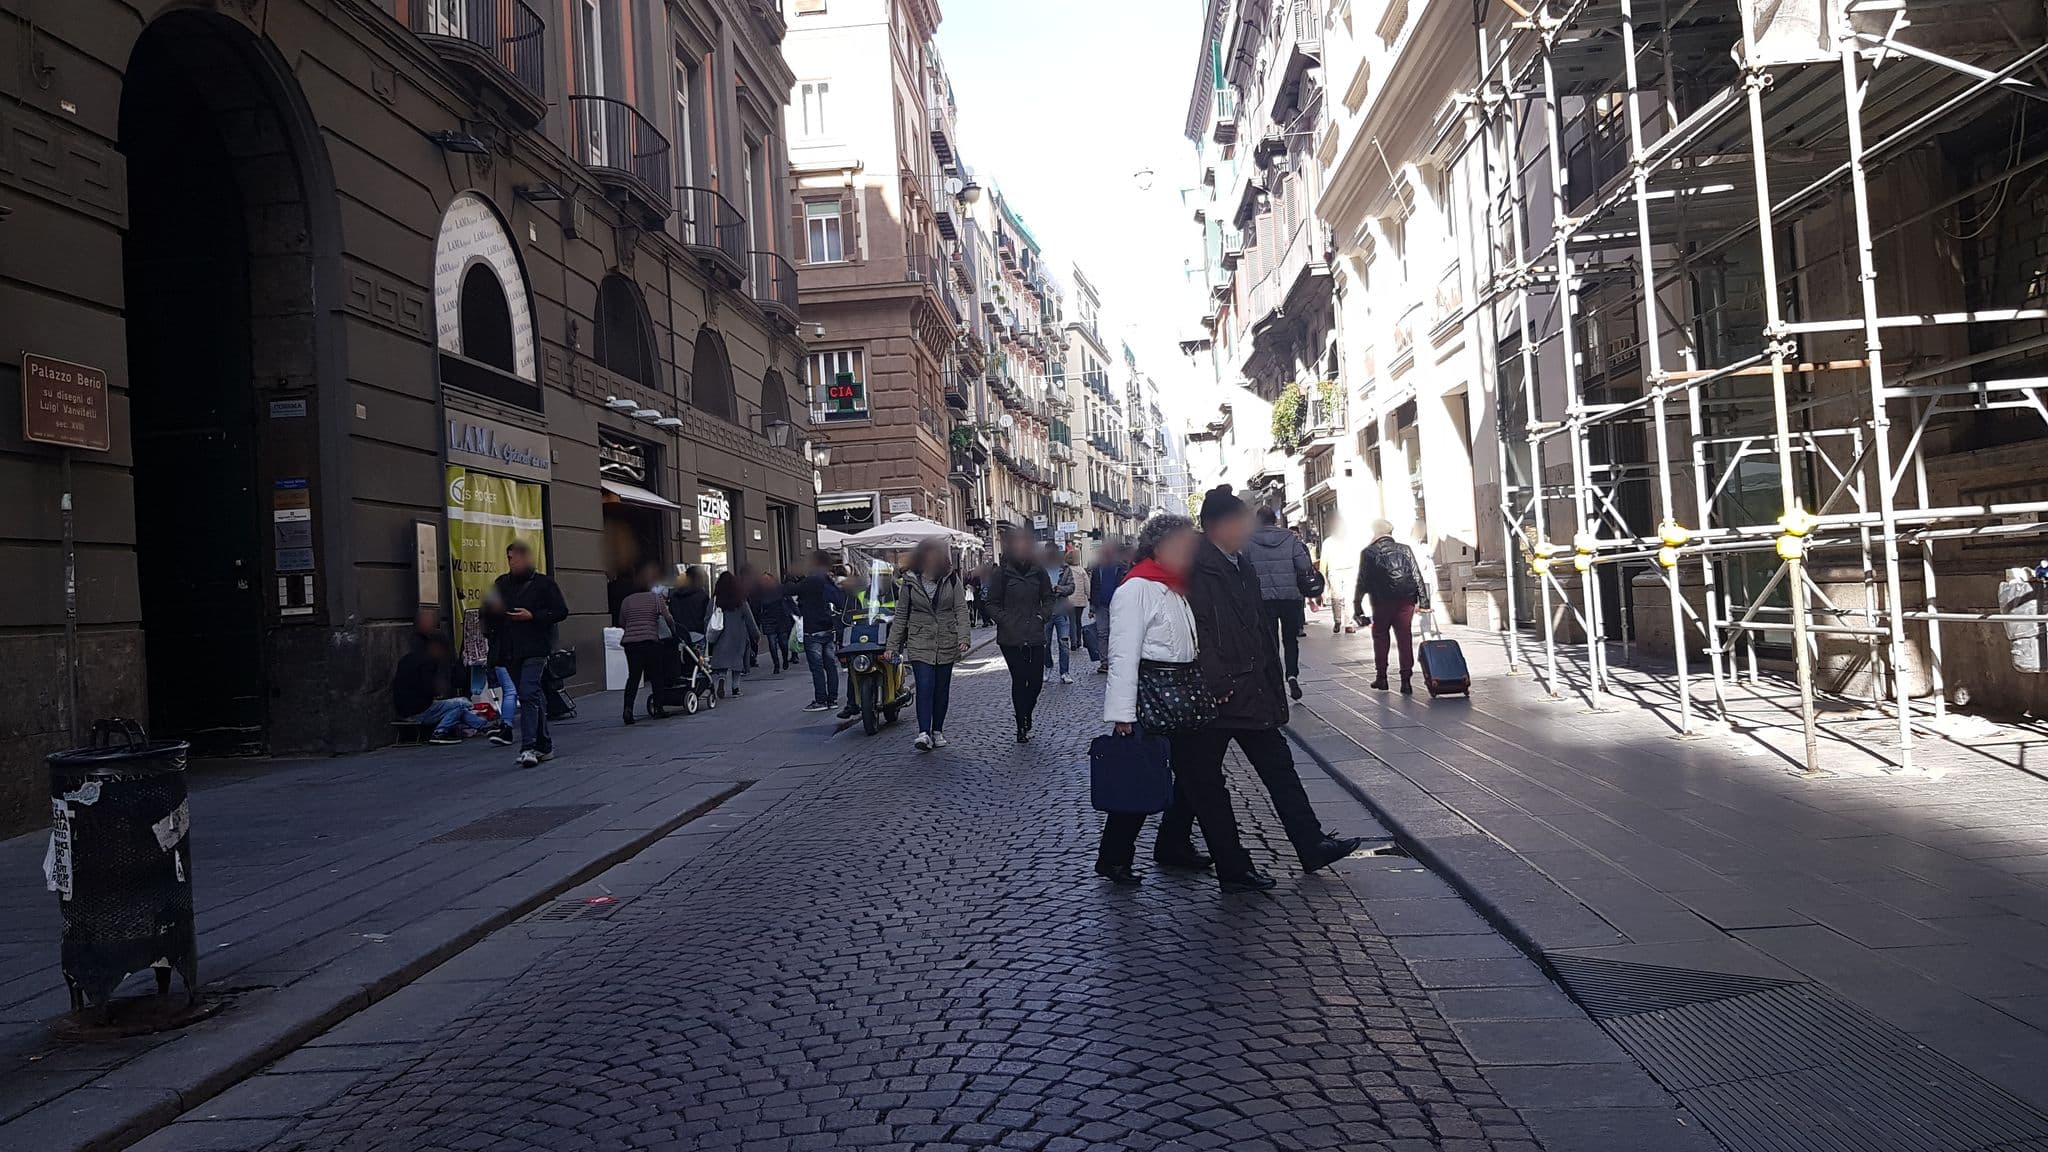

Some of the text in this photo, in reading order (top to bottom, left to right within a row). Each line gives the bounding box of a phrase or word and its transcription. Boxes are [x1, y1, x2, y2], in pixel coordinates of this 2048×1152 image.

[31, 363, 101, 389] Palazzo Berio
[42, 389, 53, 398] su
[56, 390, 83, 404] disegni
[829, 386, 853, 398] CIA
[40, 400, 59, 413] Luigi
[449, 420, 503, 459] LAMA
